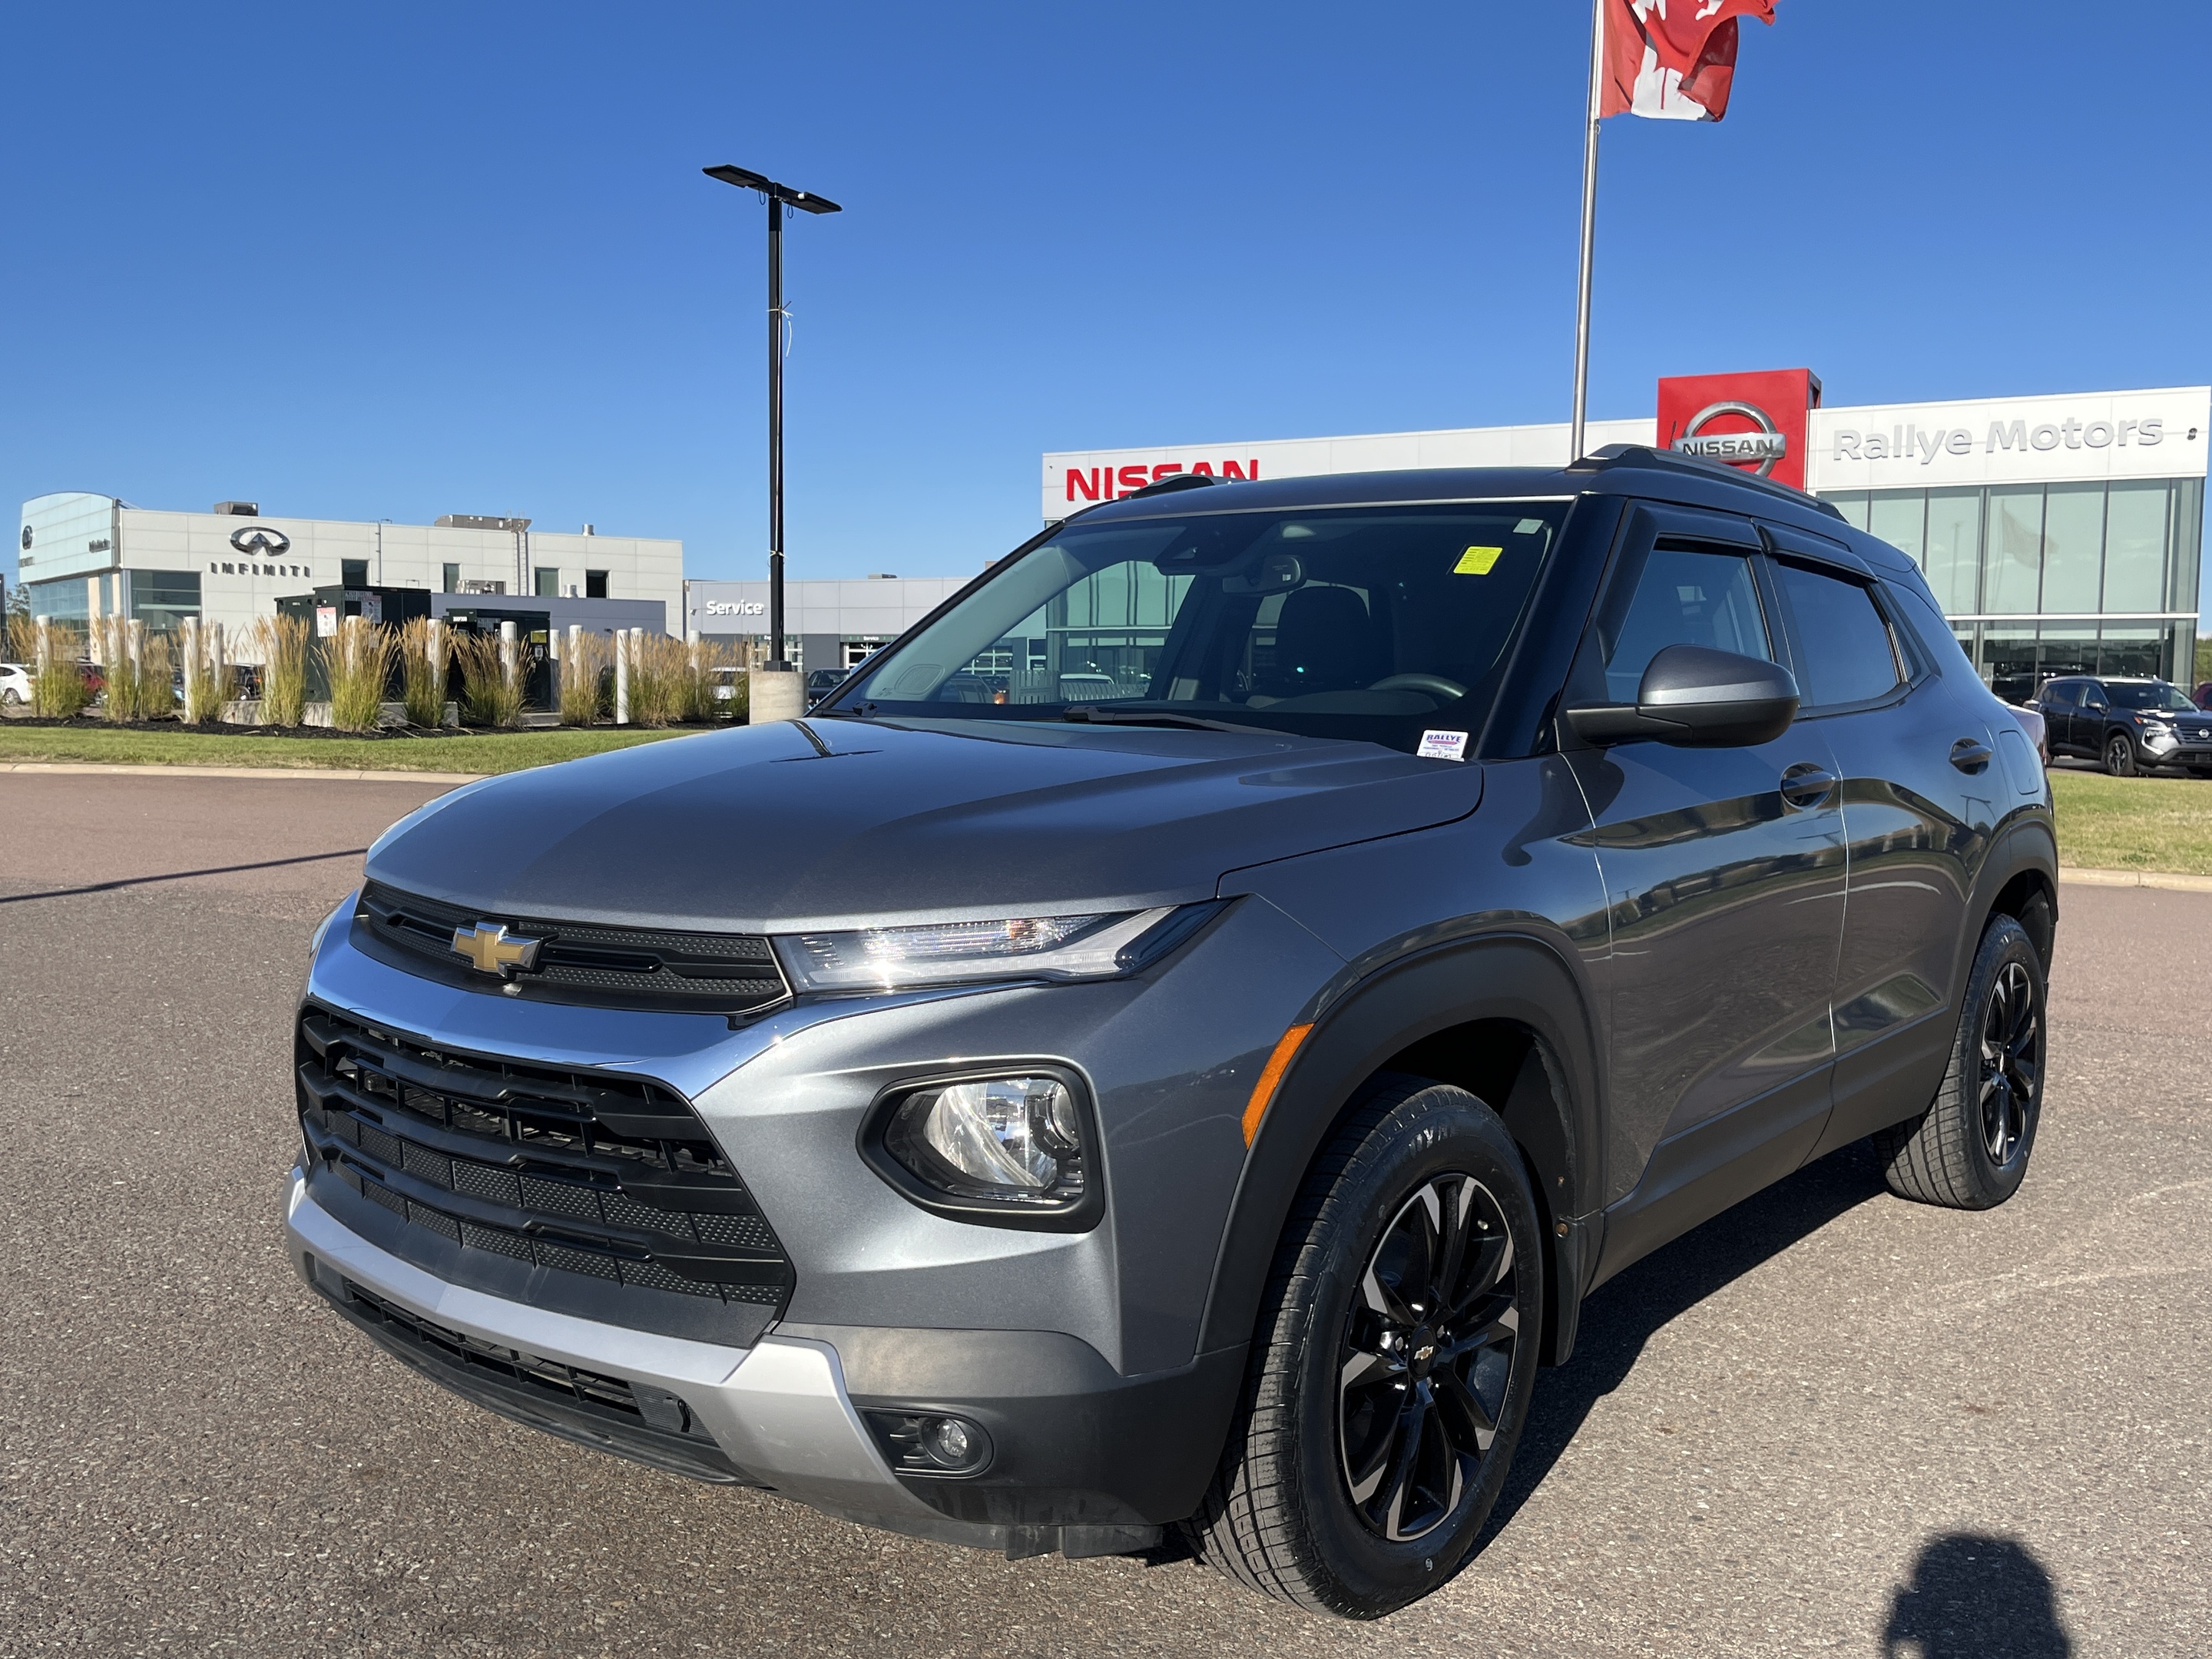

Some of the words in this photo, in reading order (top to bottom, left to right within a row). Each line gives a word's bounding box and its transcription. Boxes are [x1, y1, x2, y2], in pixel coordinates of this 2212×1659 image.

[1683, 439, 1773, 455] NISSAN
[1833, 424, 1973, 465] Rallye
[1985, 417, 2164, 453] Motors
[210, 562, 310, 578] INFINITI
[707, 599, 764, 615] Service
[1426, 734, 1462, 743] RALLYE
